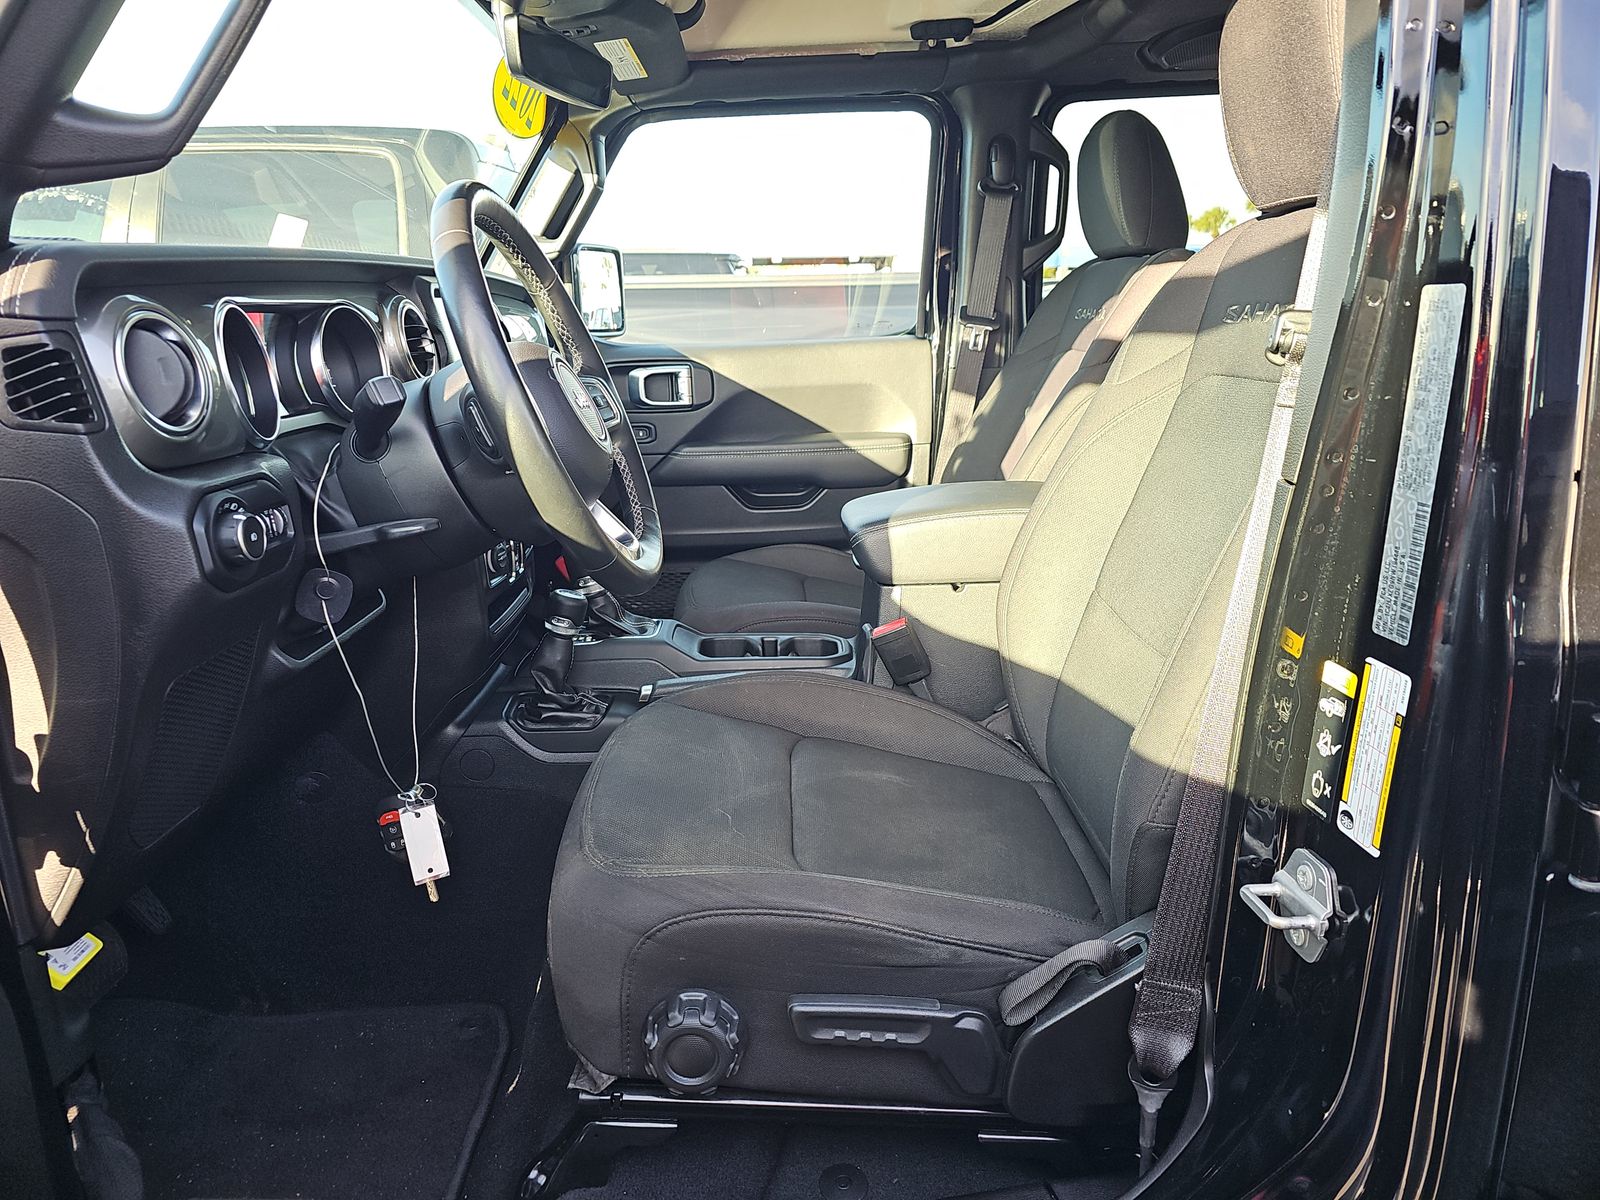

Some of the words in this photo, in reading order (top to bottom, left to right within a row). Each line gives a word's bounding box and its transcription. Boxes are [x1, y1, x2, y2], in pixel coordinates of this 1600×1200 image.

[1222, 303, 1295, 323] SAHA
[1382, 574, 1389, 585] US
[1388, 607, 1397, 636] VEHICLE
